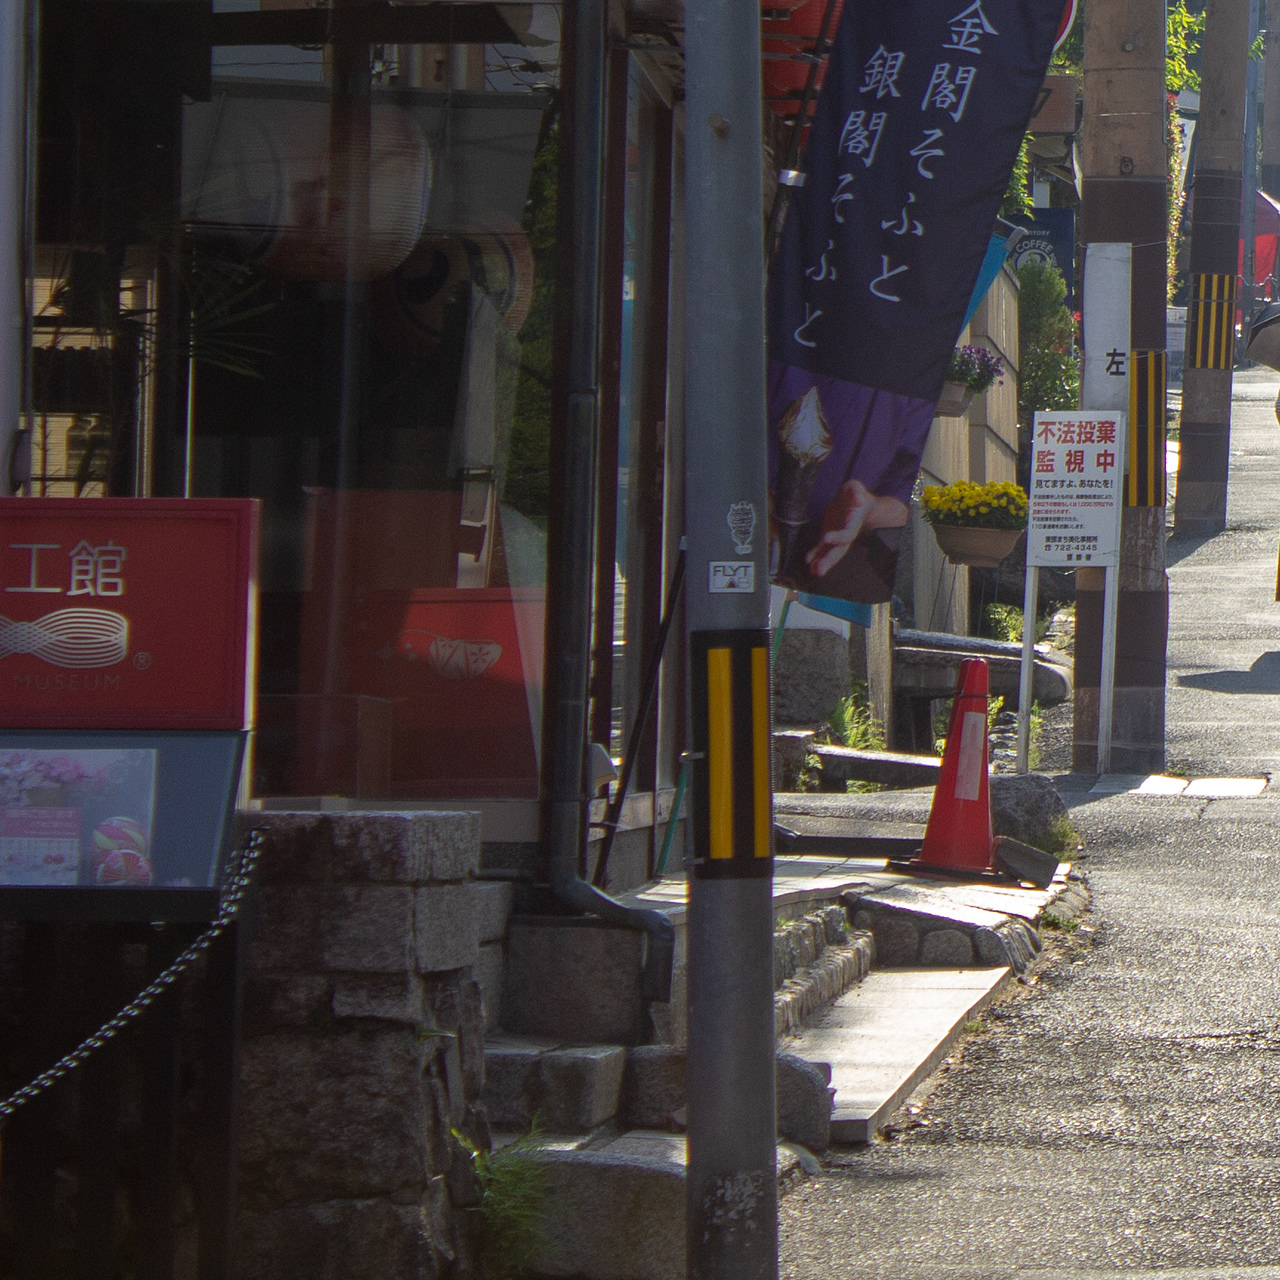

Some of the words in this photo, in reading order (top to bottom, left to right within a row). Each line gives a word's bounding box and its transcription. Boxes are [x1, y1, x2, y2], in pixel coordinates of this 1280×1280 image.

[794, 44, 904, 347] 銀閣そふと
[1016, 239, 1053, 253] COFFEE
[1105, 348, 1126, 376] 左
[1036, 420, 1116, 444] 不法投棄
[713, 565, 751, 577] FLYT
[13, 674, 121, 691] MUSEUM
